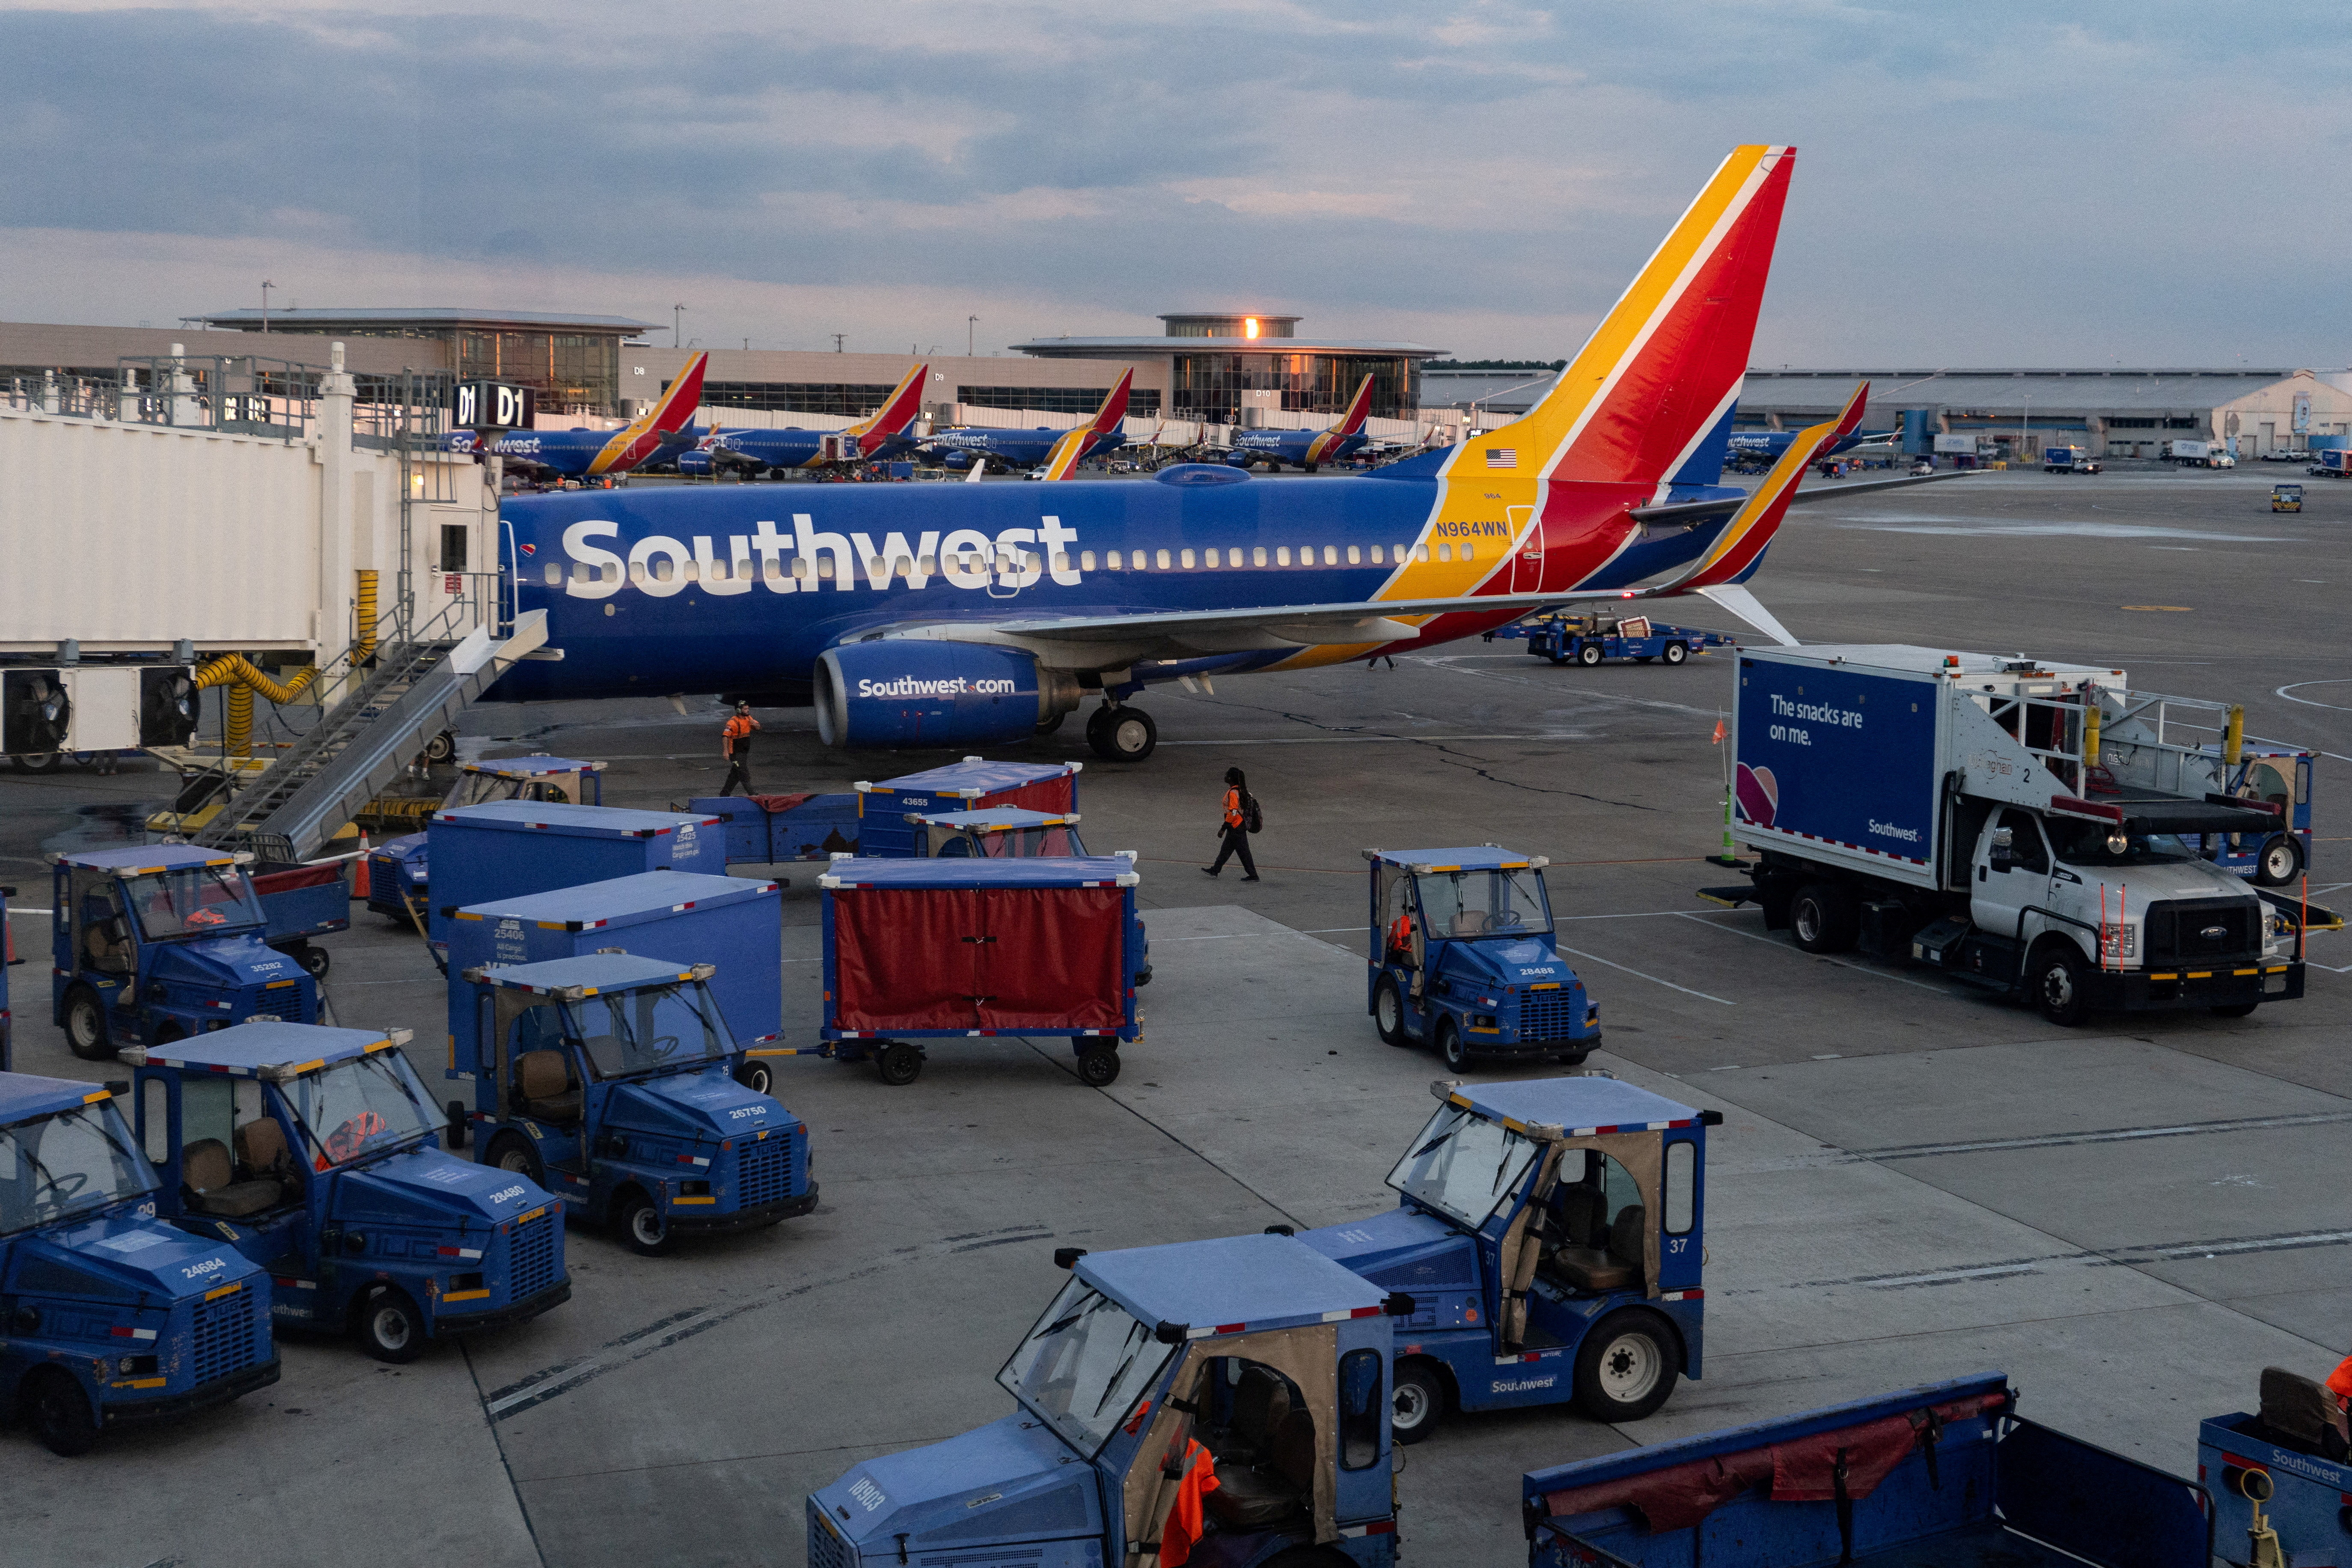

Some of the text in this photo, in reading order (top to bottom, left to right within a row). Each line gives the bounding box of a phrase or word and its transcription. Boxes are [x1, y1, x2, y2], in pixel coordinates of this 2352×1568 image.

[634, 367, 645, 375] D8
[459, 385, 476, 425] D1
[497, 386, 524, 426] D1
[450, 435, 541, 453] Sowest
[1728, 435, 1770, 447] uthwest
[1436, 521, 1508, 537] N964WN
[562, 514, 1082, 598] Southwest
[1771, 694, 1862, 729] The snacks are
[1770, 724, 1811, 746] on me.
[2023, 768, 2030, 783] 2
[903, 797, 928, 806] 43655
[677, 832, 696, 843] 25425
[1869, 819, 1918, 842] Southwest
[494, 928, 525, 940] 25406
[505, 944, 521, 952] Cargo
[250, 962, 283, 972] 35282
[729, 1106, 767, 1119] 26750
[489, 1185, 525, 1204] 28480
[1670, 1238, 1688, 1253] 37
[1485, 1250, 1496, 1267] 37
[182, 1258, 226, 1279] 24684
[2272, 1449, 2341, 1484] Southwest
[848, 1477, 886, 1512] 18903
